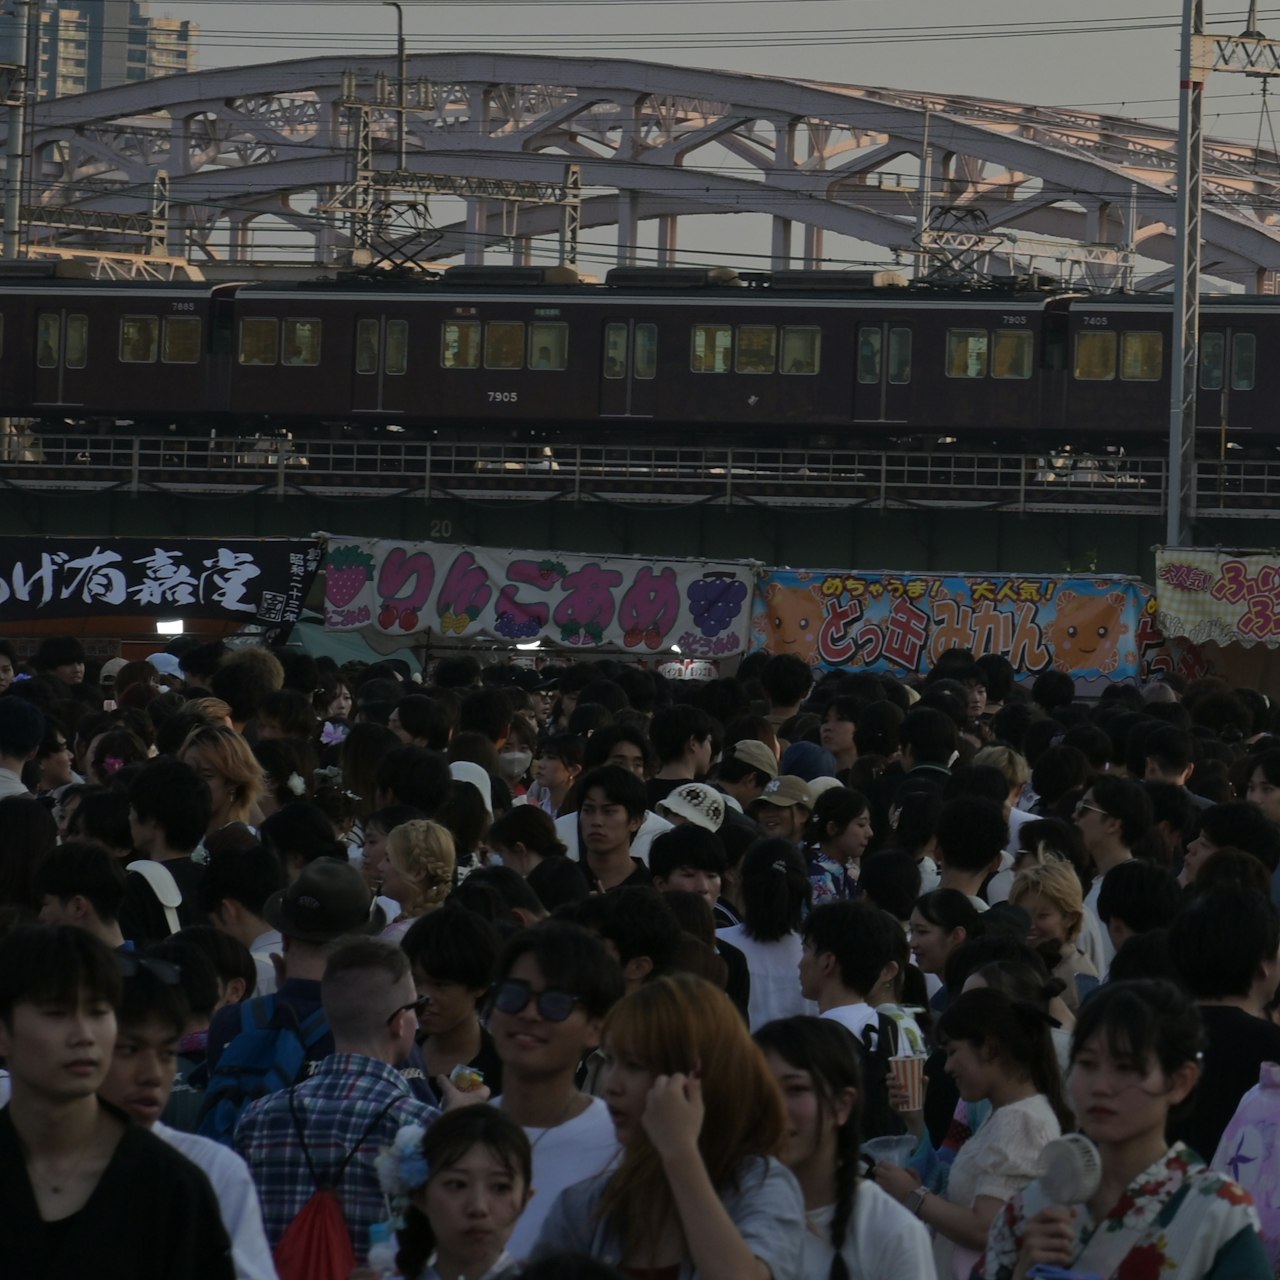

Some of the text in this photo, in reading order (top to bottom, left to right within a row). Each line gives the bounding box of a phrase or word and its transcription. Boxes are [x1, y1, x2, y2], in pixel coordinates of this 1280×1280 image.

[1082, 316, 1109, 326] 7405
[487, 391, 518, 402] 7905
[430, 520, 452, 538] 20
